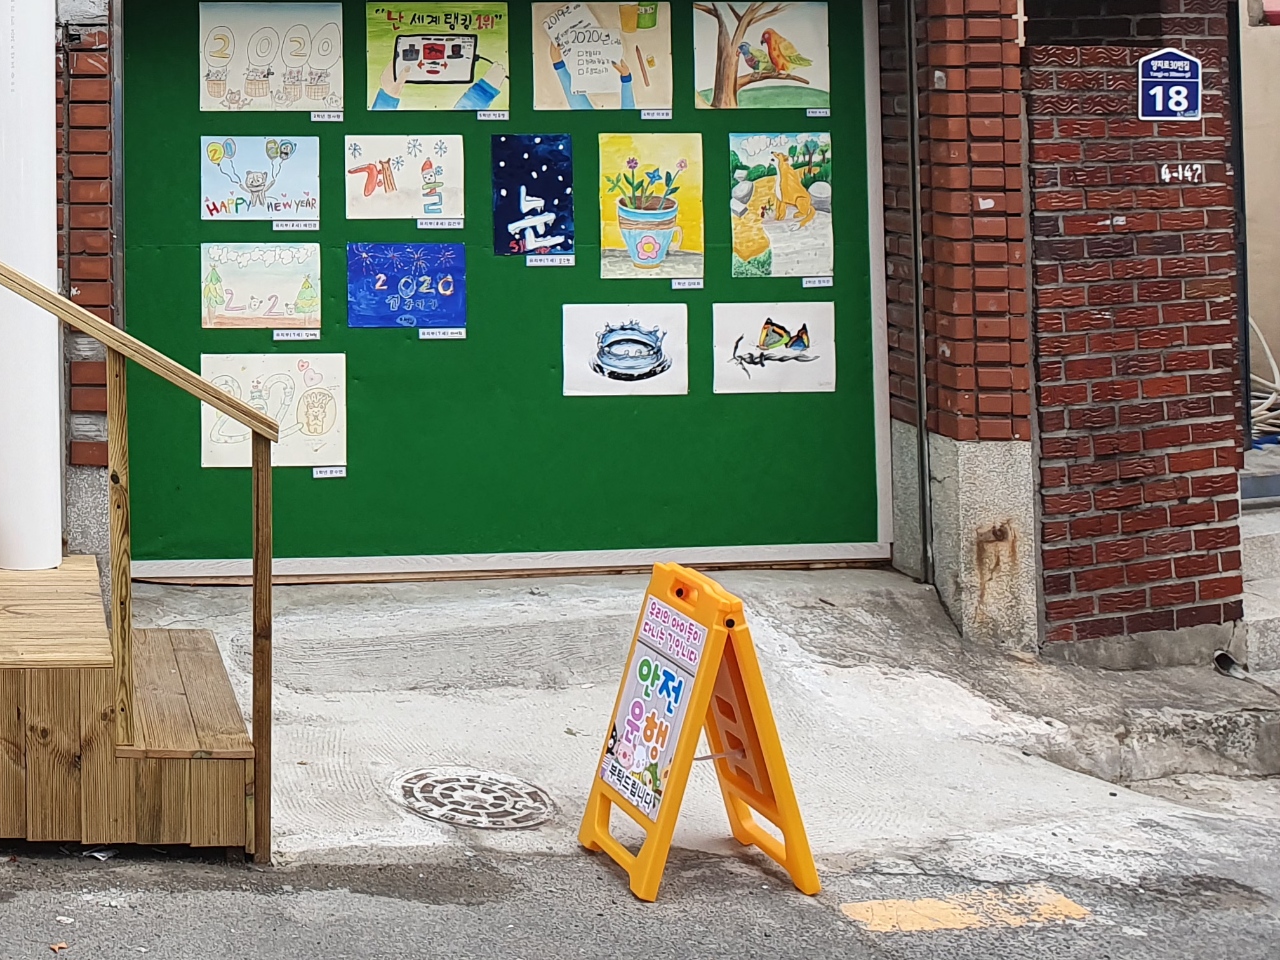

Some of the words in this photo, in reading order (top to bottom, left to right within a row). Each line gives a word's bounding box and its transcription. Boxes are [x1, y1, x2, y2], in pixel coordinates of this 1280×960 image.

[410, 13, 440, 25] 세계
[444, 12, 472, 30] 랭킹
[1148, 85, 1189, 111] 18
[205, 197, 252, 217] HAPPY
[643, 621, 665, 646] 다니는
[667, 632, 697, 664] 길입니다
[649, 601, 671, 625] 우리의
[671, 617, 701, 644] 아이들이
[638, 658, 683, 715] 안전
[624, 700, 669, 761] 운행
[609, 763, 653, 809] 부탁드립니다
